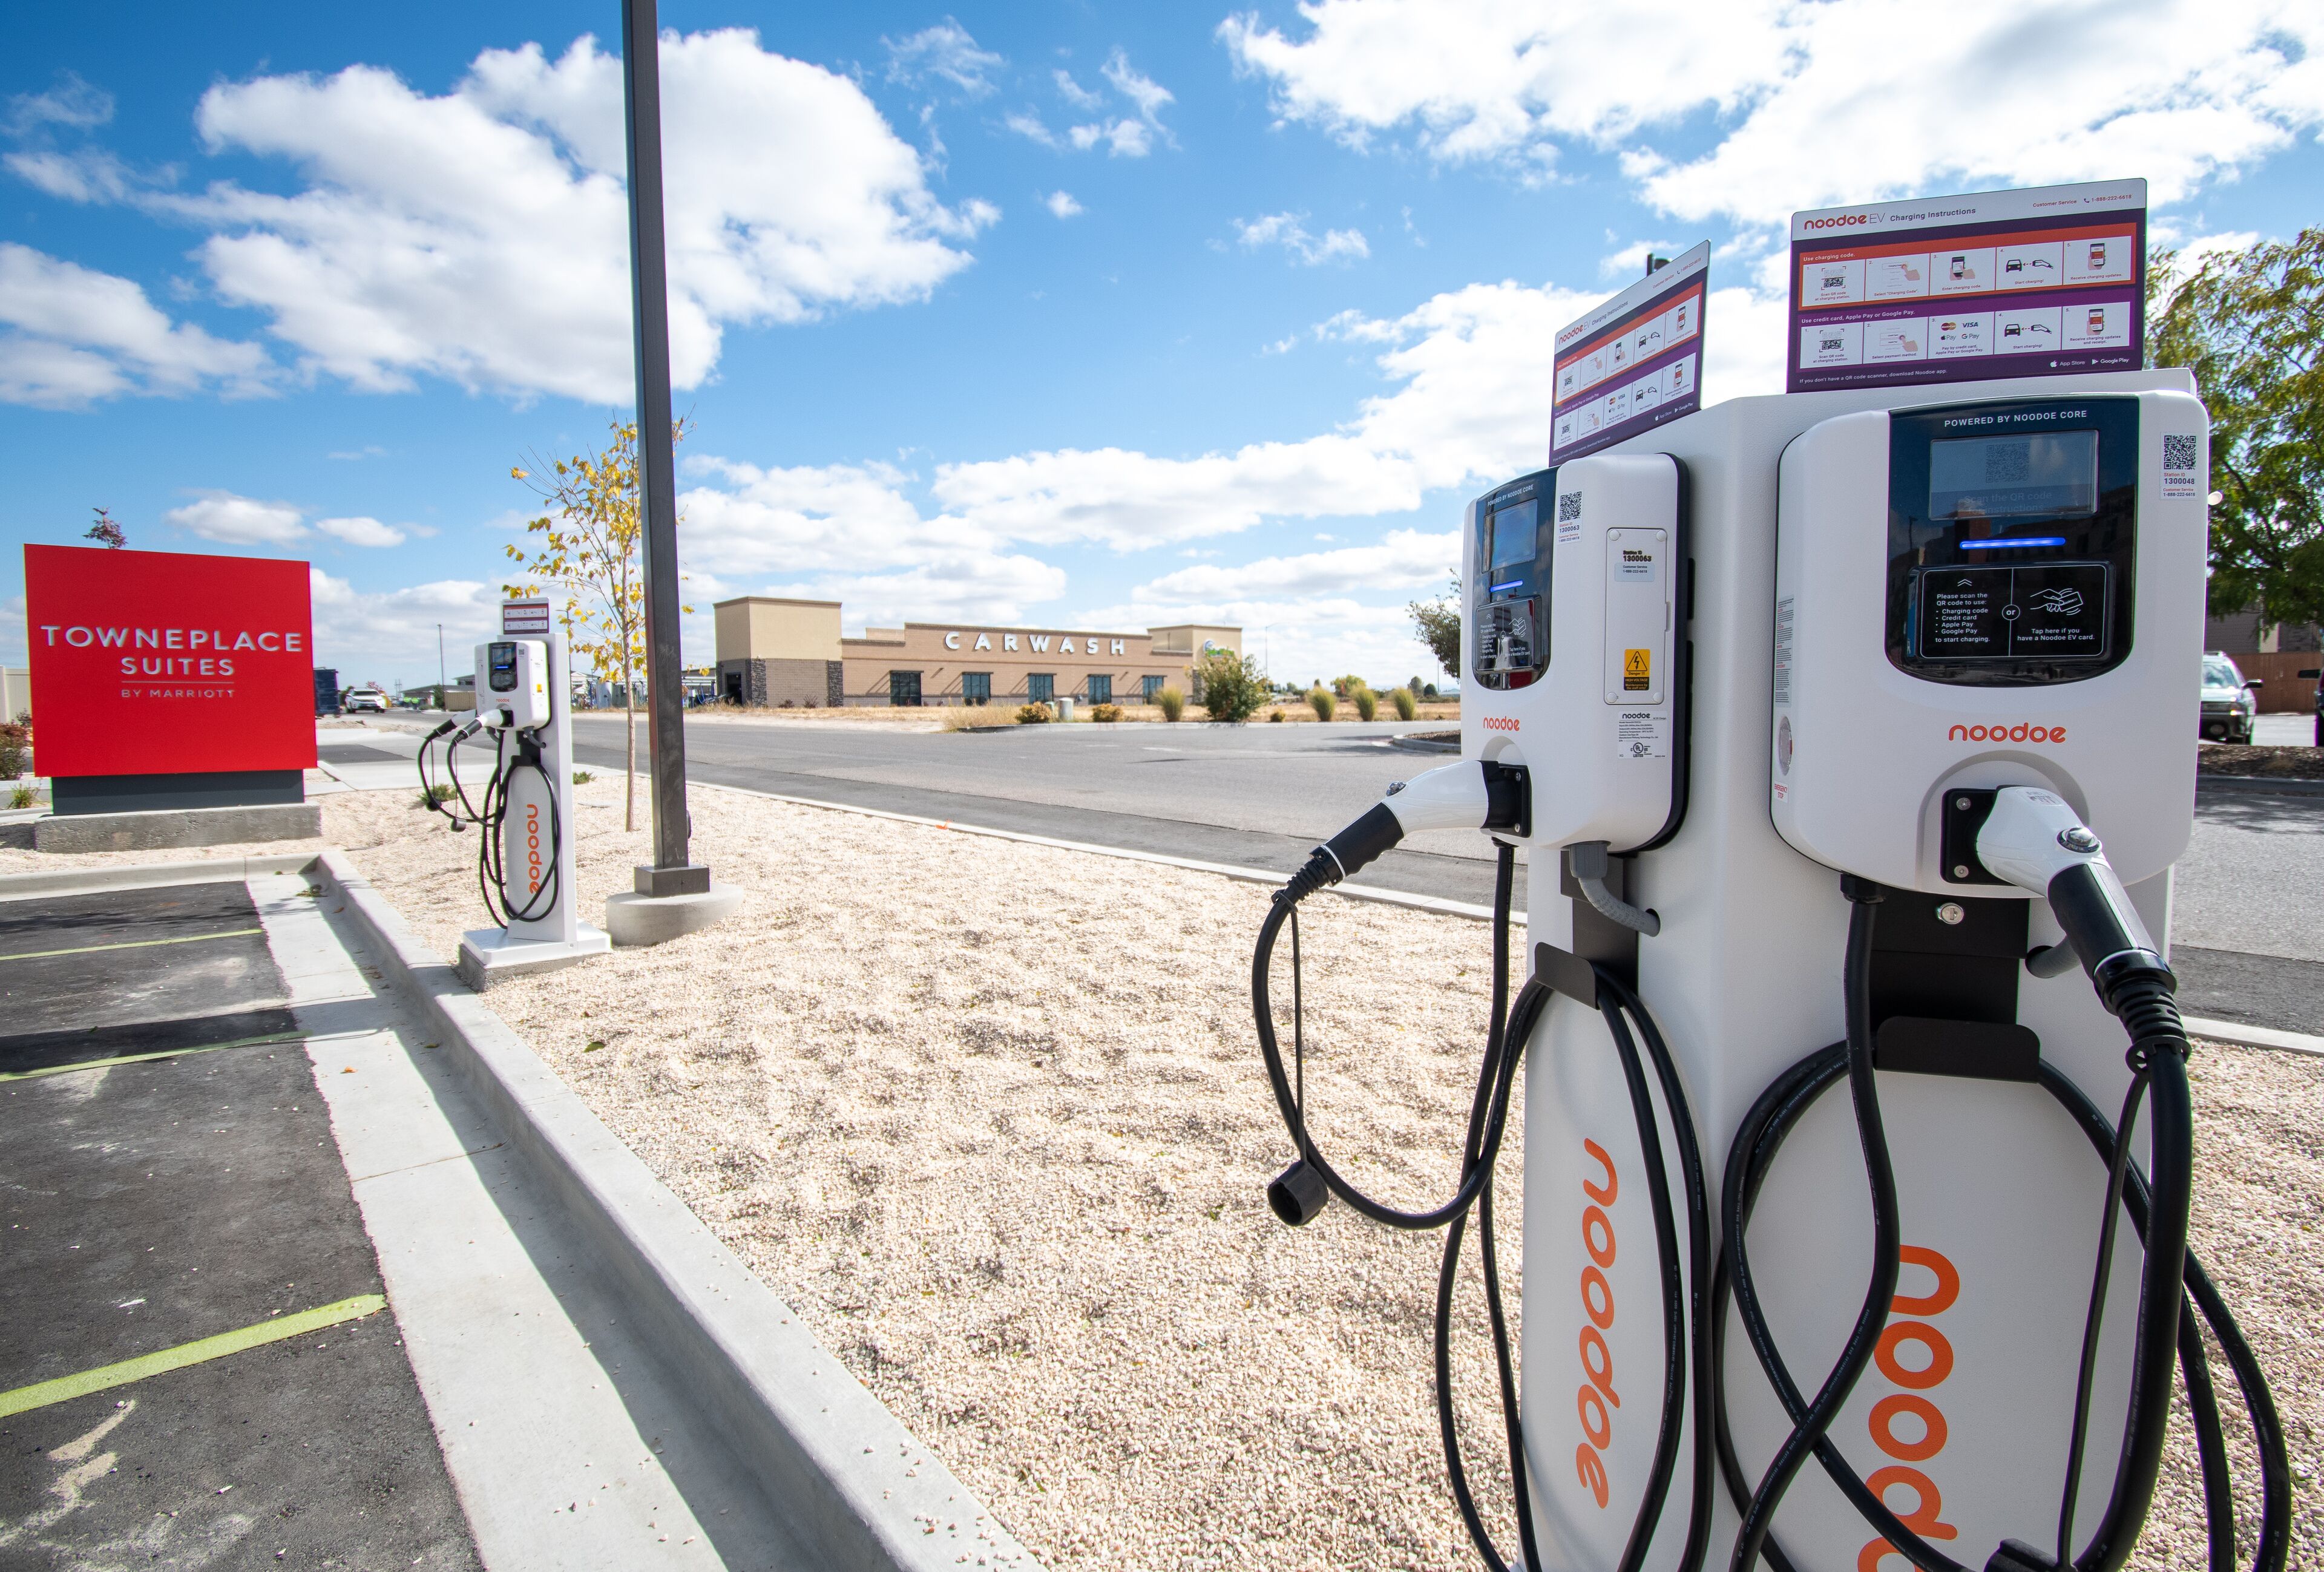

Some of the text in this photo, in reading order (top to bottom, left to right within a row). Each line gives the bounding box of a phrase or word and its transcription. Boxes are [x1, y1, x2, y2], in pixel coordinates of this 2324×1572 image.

[1804, 208, 1976, 230] noodoe EV Charging Instructions
[1558, 301, 1629, 345] noodoe EV Charging Instructions
[1945, 410, 2087, 427] POWERED BY NOODOE CORE
[1487, 496, 1502, 507] POWERED
[1507, 488, 1522, 499] NOODOE
[1523, 484, 1534, 493] CORE
[2010, 493, 2024, 502] QR
[2027, 491, 2052, 500] code
[1559, 525, 1580, 533] 1300063
[40, 625, 302, 652] TOWNEPLACE
[121, 657, 235, 676] SUITES
[121, 689, 235, 698] BY MARRIOTT
[1483, 716, 1520, 732] noodoe
[1948, 722, 2066, 744] noodoe
[527, 804, 542, 894] noodoe
[1575, 1138, 1621, 1510] noodoe
